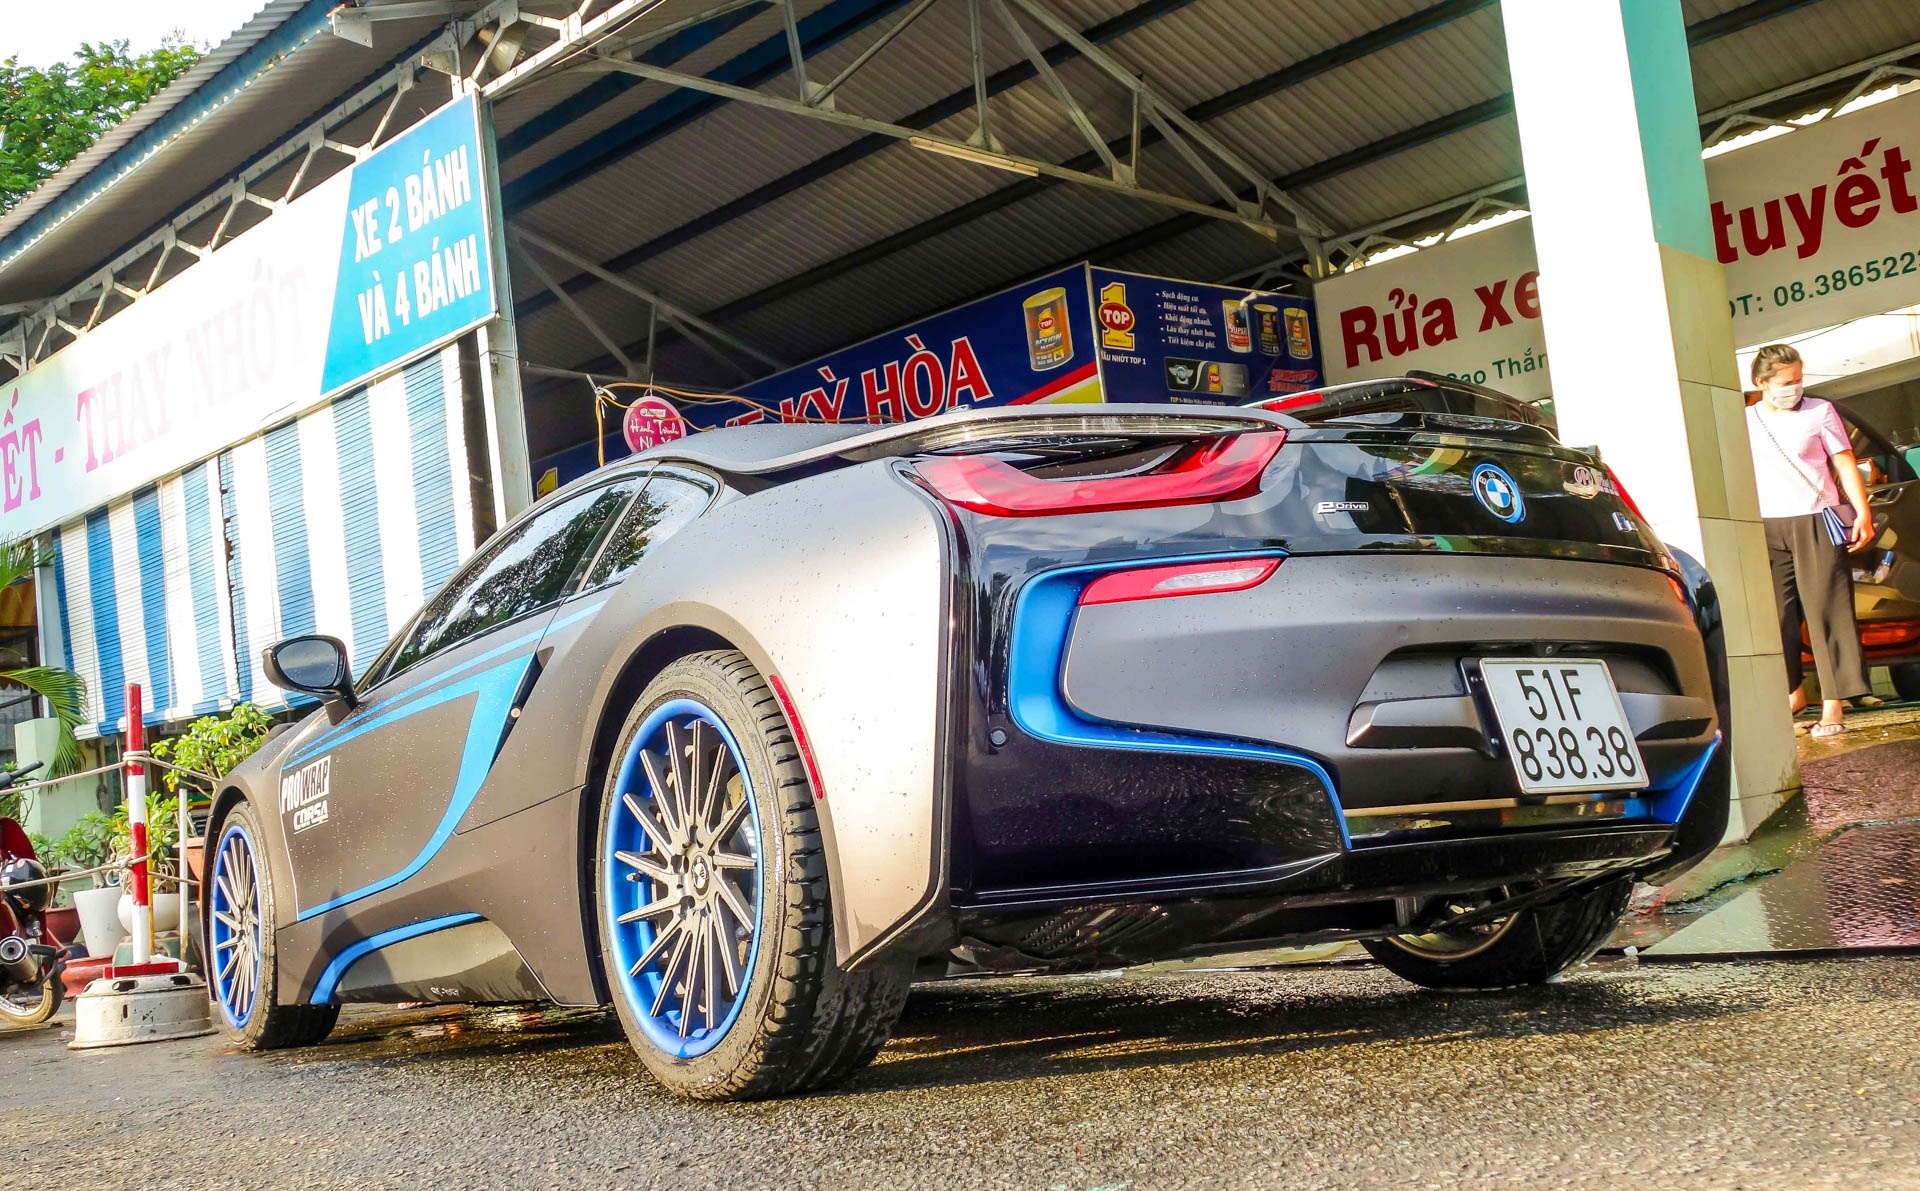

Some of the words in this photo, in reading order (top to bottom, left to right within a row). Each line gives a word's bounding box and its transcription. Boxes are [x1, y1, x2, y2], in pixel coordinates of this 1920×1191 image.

[352, 197, 383, 263] XE
[386, 186, 403, 242] 2
[404, 144, 471, 232] BÁNH
[1710, 137, 1918, 264] tuyết
[358, 271, 389, 345] VÀ
[394, 271, 411, 327] 4
[411, 233, 481, 320] BÁNH
[1176, 292, 1191, 302] động
[1040, 319, 1053, 328] TOP
[1103, 308, 1130, 325] TOP
[1178, 326, 1190, 336] thay
[1179, 314, 1193, 325] động
[1340, 287, 1459, 369] Rửa
[1473, 271, 1541, 333] xe
[1111, 354, 1129, 363] NHỚT
[1129, 357, 1141, 365] TOP
[1168, 336, 1179, 344] Tiết
[1180, 337, 1195, 346] kiệm
[1195, 339, 1205, 347] chi
[779, 365, 849, 424] KỲ
[861, 333, 994, 425] HÒA
[77, 341, 174, 473] THAY
[1515, 668, 1583, 721] 51F
[1512, 725, 1637, 783] 838.38
[293, 799, 329, 831] CORSA
